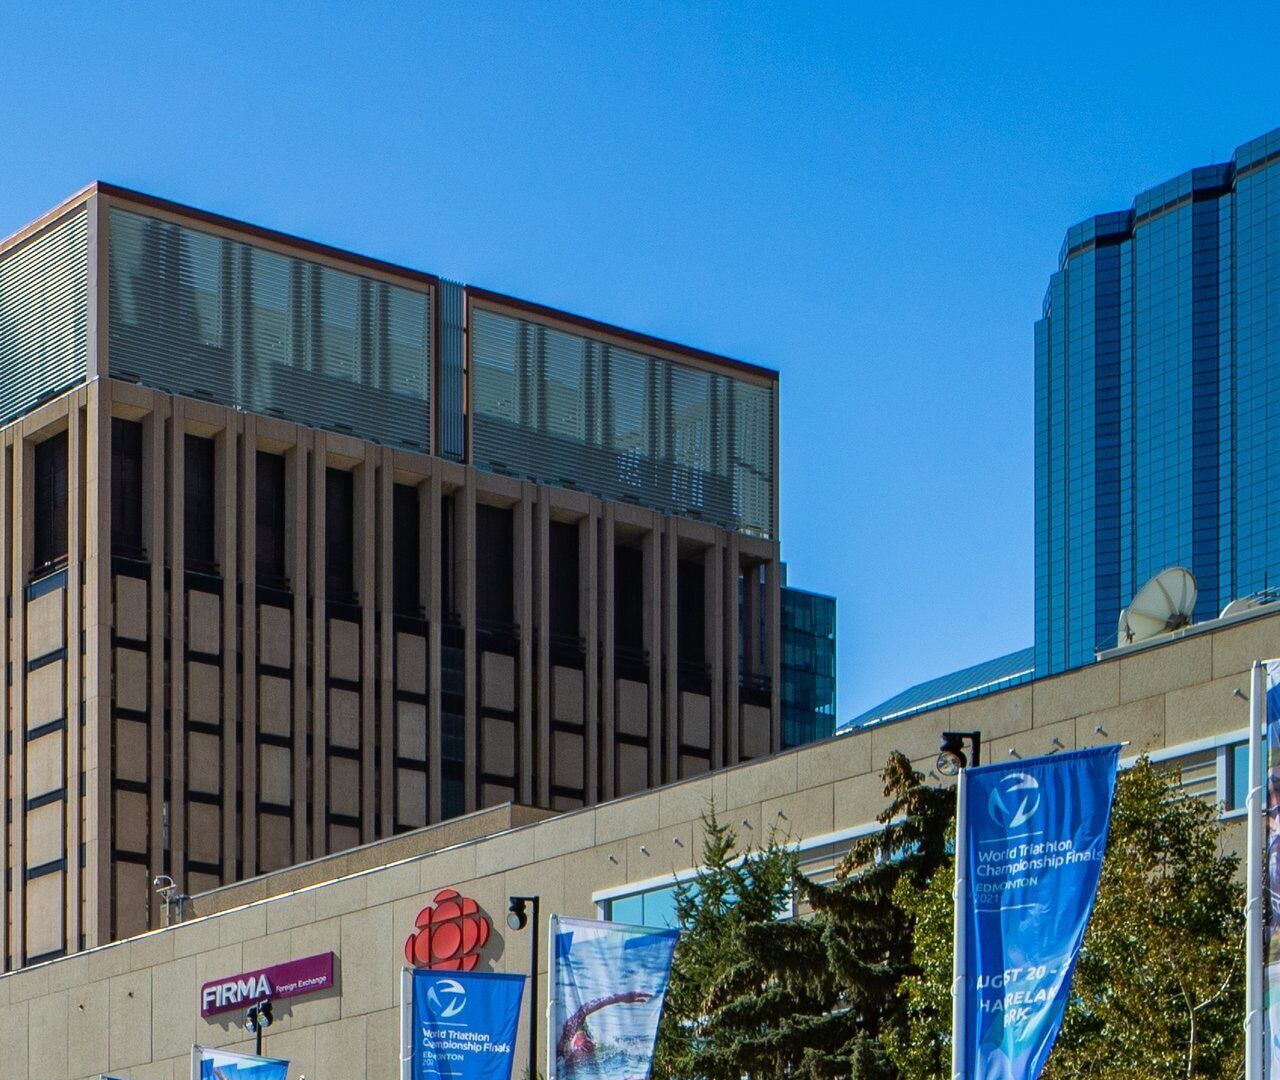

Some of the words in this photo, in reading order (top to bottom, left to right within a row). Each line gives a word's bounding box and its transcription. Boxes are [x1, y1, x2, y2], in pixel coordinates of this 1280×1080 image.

[978, 848, 1016, 862] World
[1019, 840, 1072, 856] Triathlon
[976, 855, 1063, 876] Championship
[1065, 849, 1102, 865] Finals
[976, 877, 1038, 893] EDMONTON
[1027, 965, 1046, 981] 20
[203, 974, 272, 1010] FIRMA
[276, 983, 297, 993] Foreign
[298, 975, 327, 988] Exchange
[422, 1027, 446, 1039] World
[448, 1030, 489, 1042] Triathlon
[483, 1043, 511, 1053] Finals
